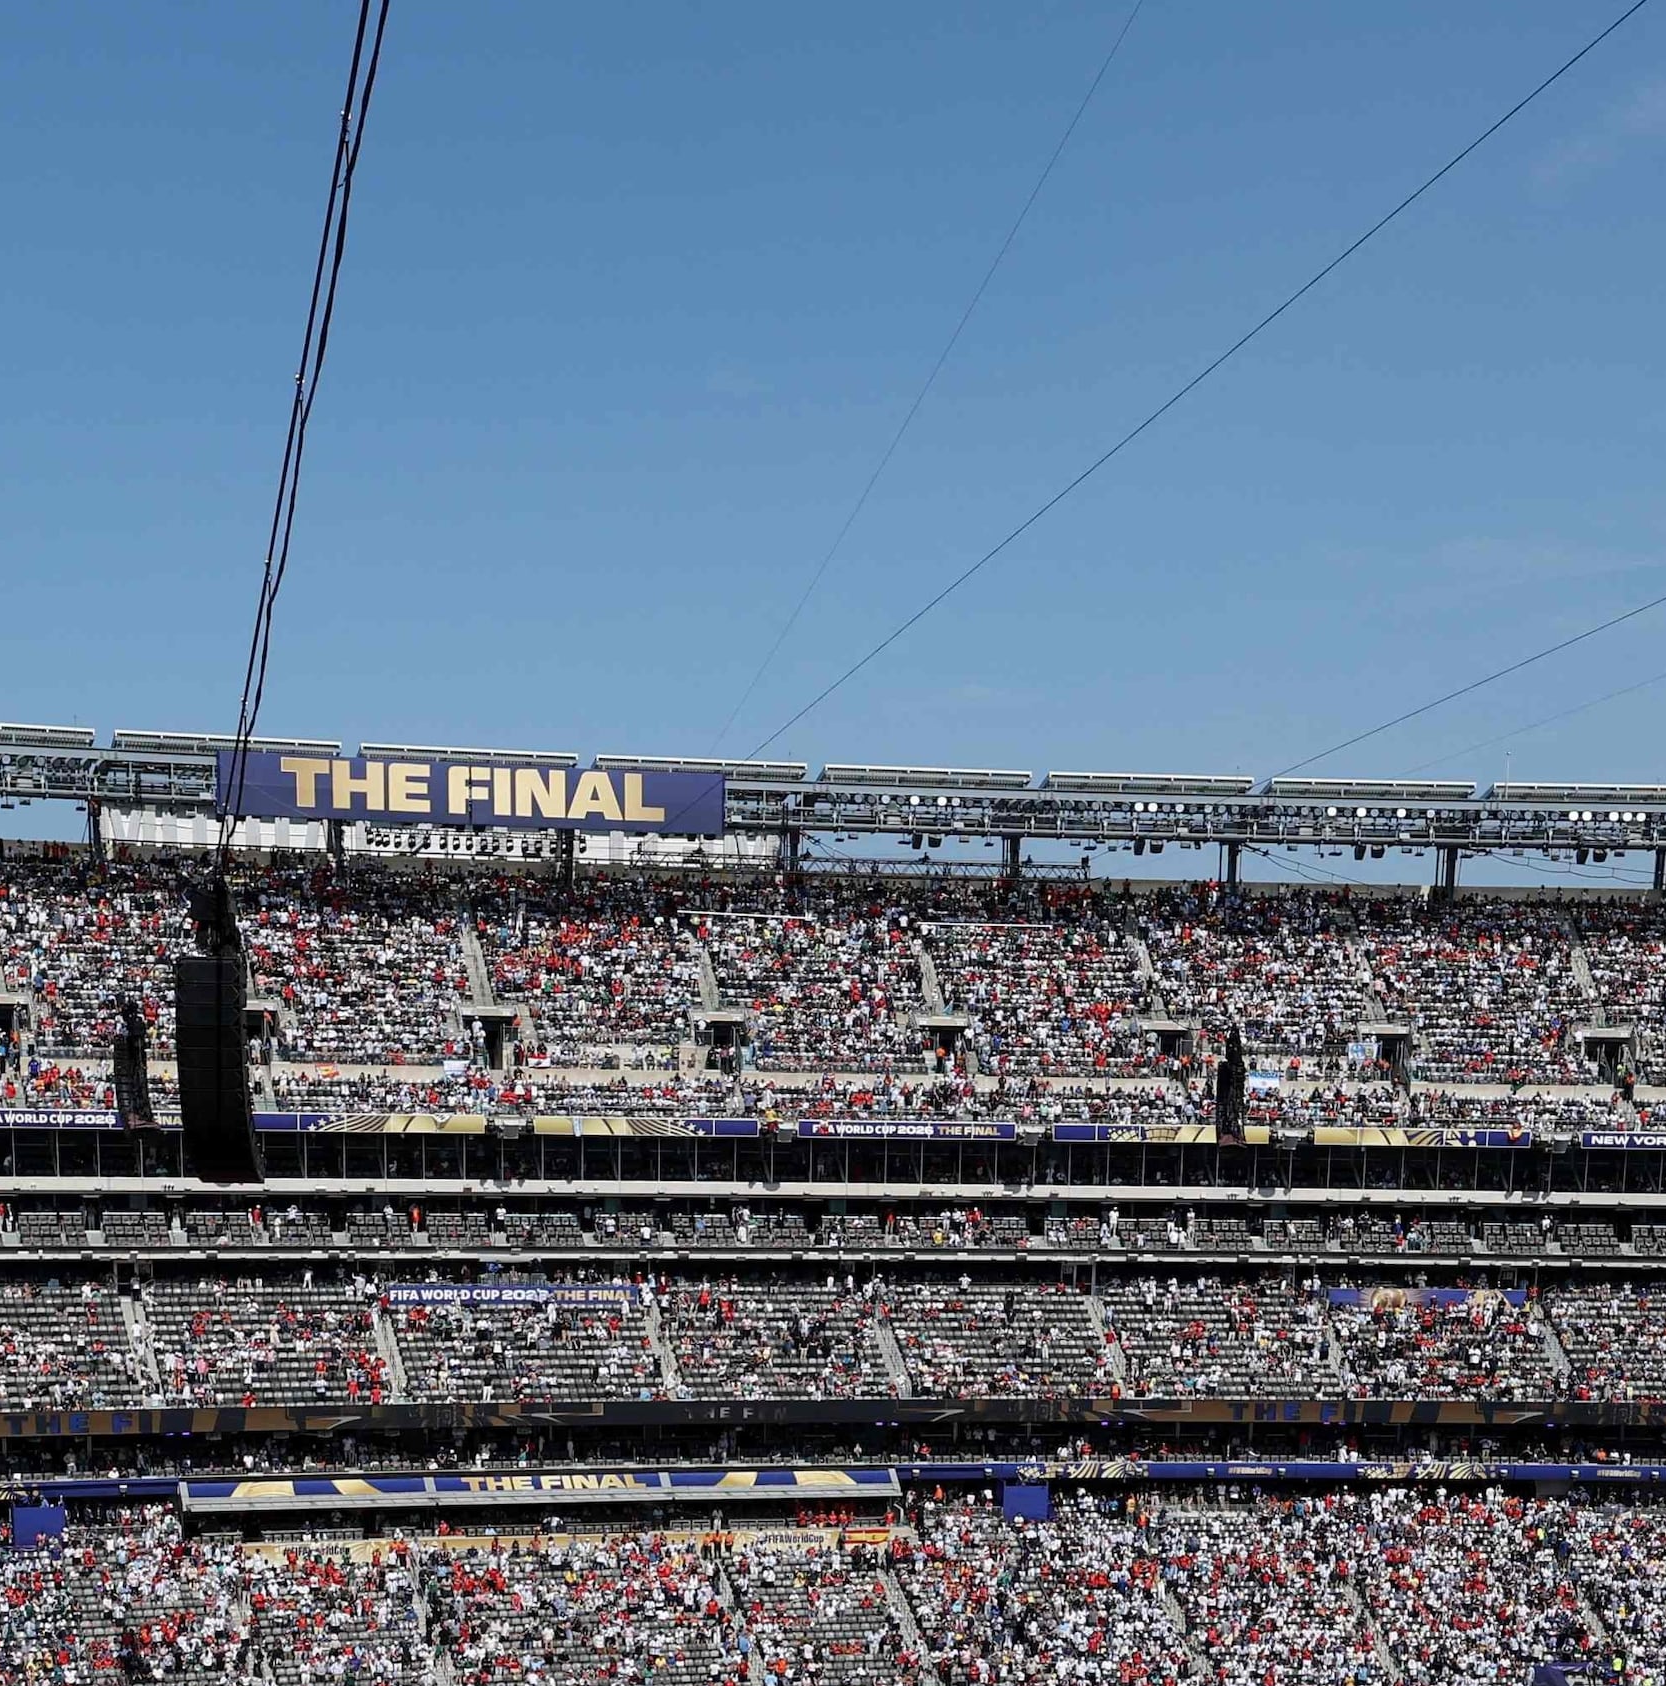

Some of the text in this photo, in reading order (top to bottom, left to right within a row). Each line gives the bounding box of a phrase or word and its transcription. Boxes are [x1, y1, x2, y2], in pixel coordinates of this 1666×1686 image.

[280, 757, 665, 822] THE FINAL
[6, 1112, 47, 1125] WORLD
[52, 1113, 72, 1125] CUP
[74, 1113, 116, 1125] 2026
[835, 1124, 1000, 1136] WORLD CUP 2026 THE FINAL
[1590, 1134, 1629, 1147] NEW
[461, 1474, 647, 1491] THE FINAL
